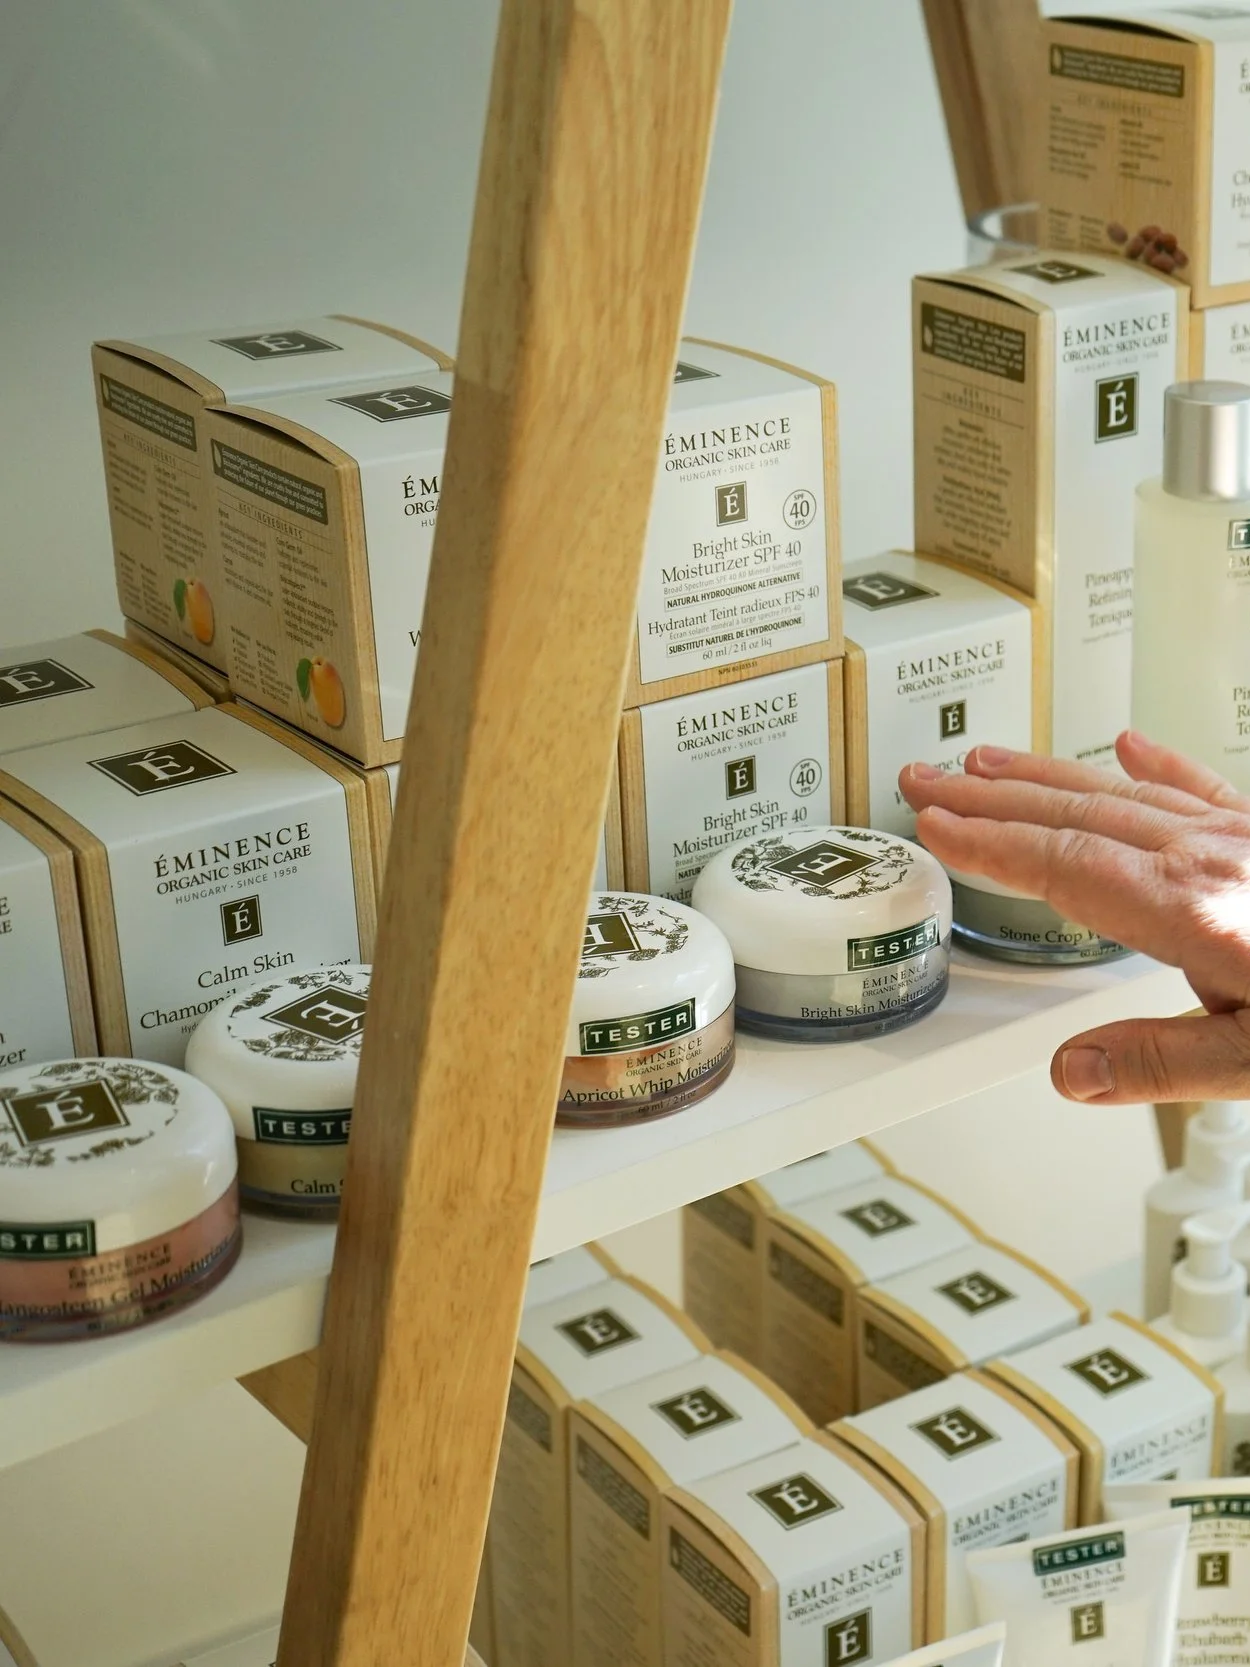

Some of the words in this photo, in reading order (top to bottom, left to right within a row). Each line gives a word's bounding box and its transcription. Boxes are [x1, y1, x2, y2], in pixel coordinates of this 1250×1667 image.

[245, 335, 306, 353] É
[1063, 312, 1172, 347] ÉMINENCE
[1062, 344, 1114, 363] ORGANIC
[1115, 338, 1141, 353] SKIN
[1143, 333, 1168, 348] CARE
[366, 390, 432, 413] É
[1107, 381, 1128, 428] É
[664, 417, 792, 456] ÉMINENCE
[665, 450, 725, 472] ORGANIC
[727, 444, 757, 462] SKIN
[759, 438, 791, 454] CARE
[679, 468, 722, 483] HUNGARY
[729, 462, 755, 473] SINCE
[723, 487, 740, 517] É
[789, 499, 810, 519] 40
[693, 535, 738, 560] Bright
[741, 530, 772, 550] Skin
[661, 556, 750, 585] Moisturizer
[753, 545, 781, 565] SPF
[784, 540, 802, 556] 40
[663, 585, 684, 595] Broad
[684, 578, 715, 593] Spectrum
[667, 594, 700, 609] NATURAL
[700, 582, 757, 602] HYDROQUINONE
[758, 571, 801, 589] ALTERNATIVE
[648, 613, 707, 638] Hydratant
[709, 606, 738, 624] Teint
[740, 597, 782, 616] radieux
[784, 589, 806, 605] FPS
[807, 585, 820, 599] 40
[668, 639, 704, 654] SUBSTITUT
[705, 632, 735, 647] NATUREL
[736, 630, 745, 640] DE
[745, 616, 802, 638] L'HYDROQUINONE
[702, 651, 713, 661] 60
[761, 636, 772, 650] liq
[896, 639, 1006, 681] ÉMINENCE
[1, 667, 55, 694] É
[897, 673, 949, 697] ORGANIC
[950, 665, 977, 683] SKIN
[978, 658, 1005, 676] CARE
[676, 692, 799, 737] ÉMINENCE
[946, 704, 960, 732] É
[677, 728, 734, 753] ORGANIC
[737, 721, 765, 738] SKIN
[768, 712, 798, 729] CARE
[691, 746, 732, 761] HUNGARY
[739, 737, 764, 749] SINCE
[768, 731, 787, 742] 1958
[128, 751, 195, 782] É
[733, 762, 749, 790] É
[796, 768, 816, 787] 40
[672, 824, 758, 858] Moisturizer
[761, 812, 789, 833] SPF
[791, 806, 808, 822] 40
[703, 808, 747, 832] Bright
[750, 799, 779, 817] Skin
[153, 822, 311, 879] ÉMINENCE
[157, 866, 230, 896] ORGANIC
[233, 855, 270, 876] SKIN
[273, 844, 312, 865] CARE
[175, 885, 228, 905] HUNGARY
[237, 873, 268, 889] SINCE
[273, 866, 298, 879] 1958
[232, 902, 252, 934] É
[859, 927, 935, 960] TESTER
[1000, 925, 1040, 943] Stone
[1044, 928, 1082, 946] Crop
[197, 964, 248, 989] Calm
[254, 951, 295, 974] Skin
[862, 959, 929, 990] ÉMINENCE
[862, 984, 897, 998] ORGANIC
[897, 979, 914, 993] SKIN
[914, 970, 929, 984] CARE
[801, 1006, 842, 1021] Bright
[845, 1003, 876, 1017] Skin
[878, 983, 936, 1011] Moisturizer
[590, 1010, 688, 1044] TESTER
[625, 1036, 703, 1070] ÉMINENCE
[625, 1062, 665, 1077] ORGANIC
[666, 1056, 685, 1069] SKIN
[685, 1049, 703, 1062] CARE
[563, 1086, 625, 1108] Apricot
[629, 1077, 673, 1097] Whip
[36, 1090, 95, 1130] É
[264, 1119, 352, 1136] TESTE
[290, 1178, 336, 1194] Calm
[68, 1242, 171, 1282] ÉMINENCE
[110, 1280, 144, 1307] Gel
[957, 1276, 997, 1305] É
[577, 1312, 620, 1345] É
[1088, 1354, 1129, 1386] É
[674, 1393, 717, 1426] É
[932, 1414, 977, 1446] É
[1110, 1415, 1209, 1468] ÉMINENCE
[773, 1482, 818, 1515] É
[952, 1479, 1061, 1534] ÉMINENCE
[1039, 1536, 1123, 1566] TESTER
[787, 1547, 905, 1608] ÉMINENCE
[1041, 1561, 1125, 1590] ÉMINENCE
[1205, 1555, 1224, 1582] É
[786, 1593, 842, 1621] ORGANIC
[845, 1580, 873, 1597] SKIN
[874, 1566, 904, 1585] CARE
[1079, 1606, 1098, 1635] É
[836, 1619, 860, 1661] É
